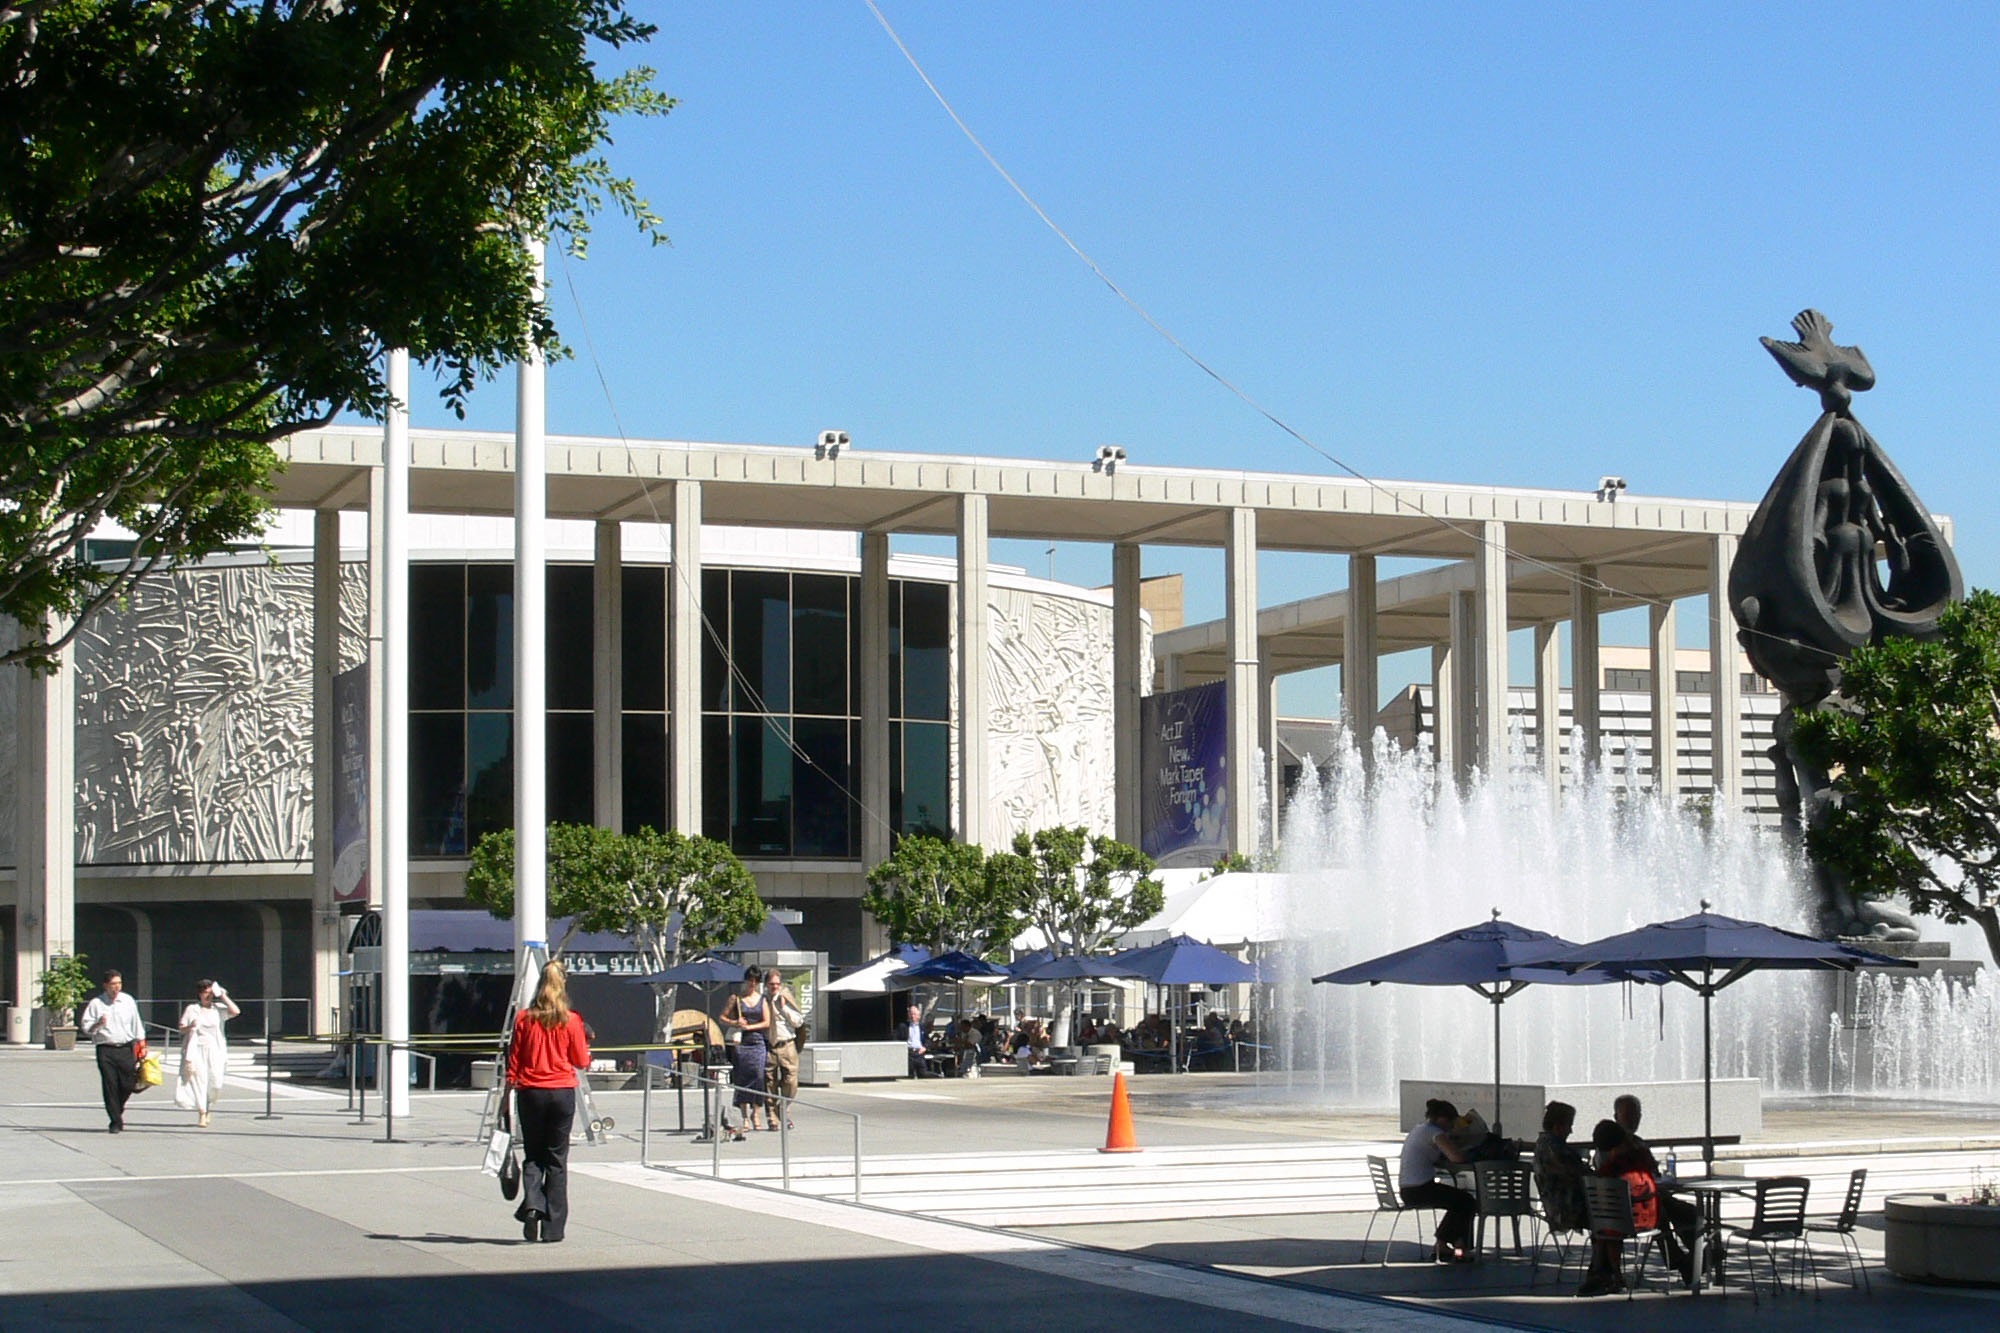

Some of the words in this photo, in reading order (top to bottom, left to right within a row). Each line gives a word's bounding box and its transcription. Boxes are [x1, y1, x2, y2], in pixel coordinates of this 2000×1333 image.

[1160, 722, 1174, 742] Act
[1160, 765, 1180, 788] Mark
[1180, 764, 1205, 788] Taper
[1169, 787, 1197, 806] Forum
[800, 984, 813, 1017] USIC
